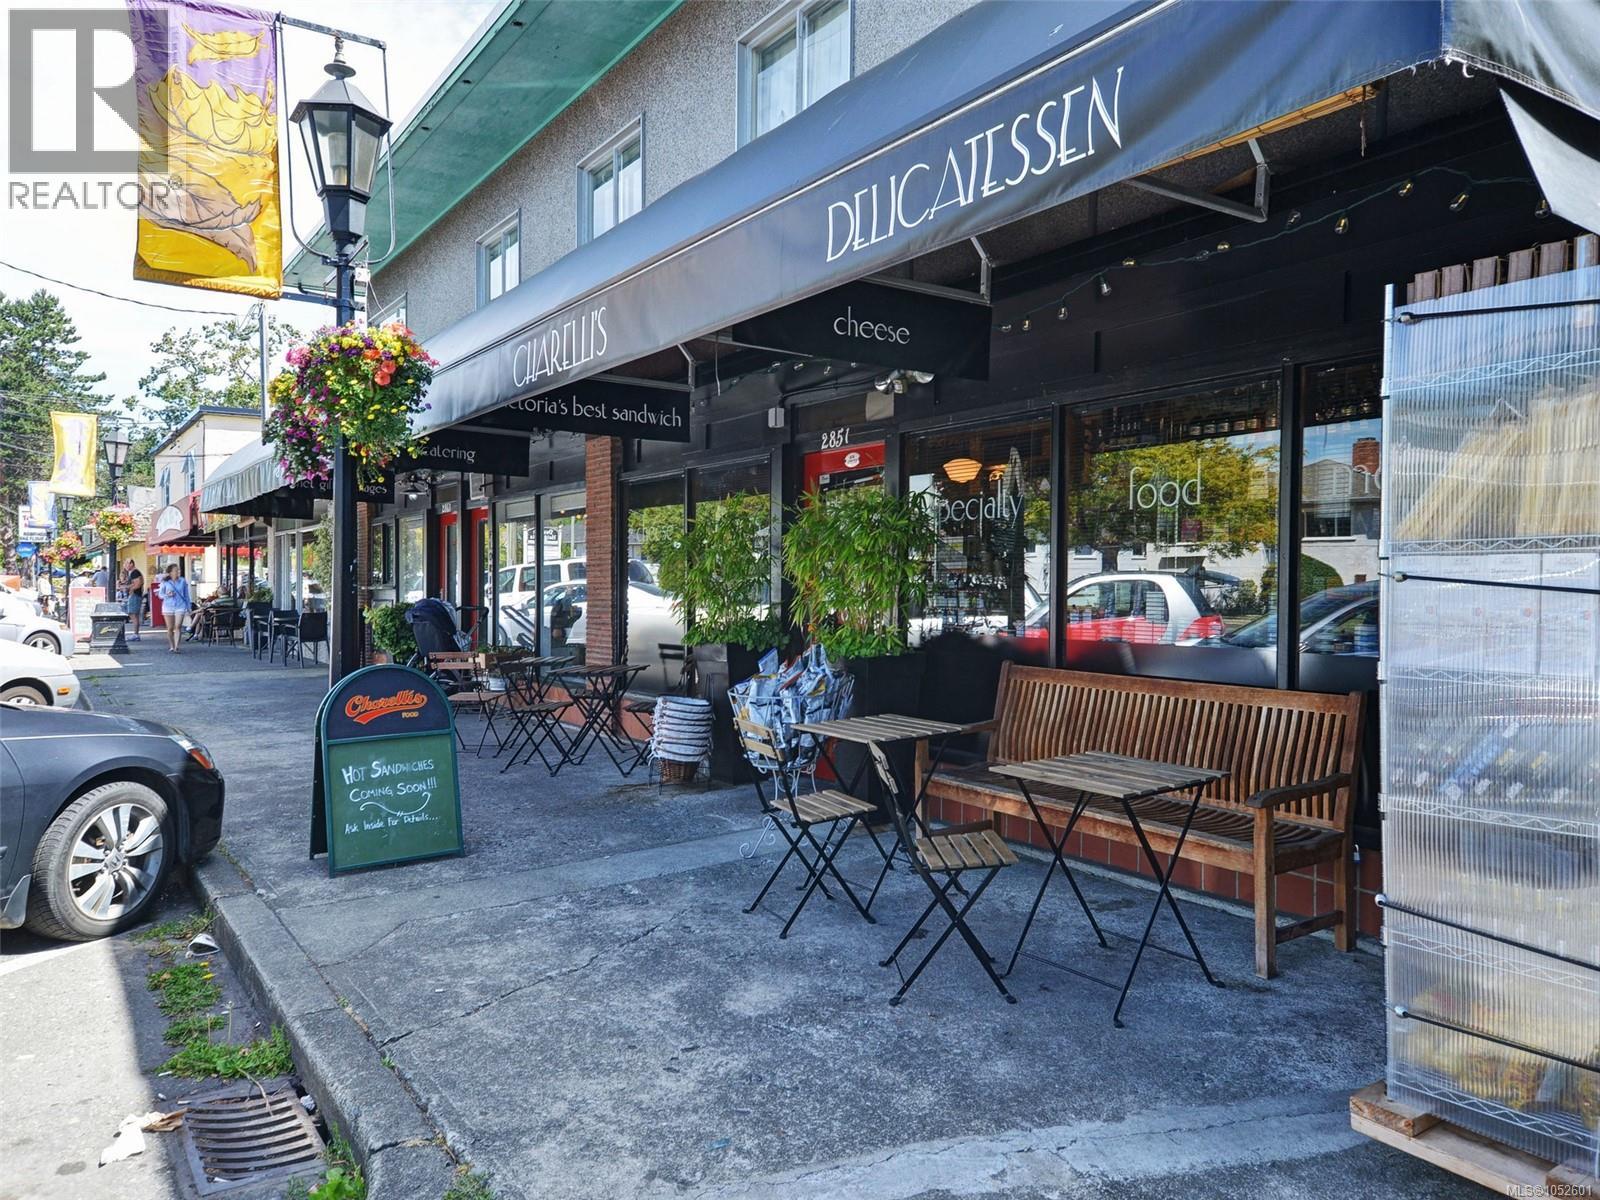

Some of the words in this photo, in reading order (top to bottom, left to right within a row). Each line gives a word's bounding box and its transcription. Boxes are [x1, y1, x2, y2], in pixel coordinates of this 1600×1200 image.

[826, 66, 1124, 263] DELICATESSEN
[834, 306, 910, 344] cheese
[513, 306, 607, 387] CHARELLI'S
[573, 395, 607, 419] best
[612, 403, 681, 427] sandwich
[821, 427, 850, 449] 2851
[1129, 457, 1201, 510] food
[936, 480, 1024, 529] pecialty
[342, 765, 366, 784] HOT
[349, 786, 393, 802] COMING
